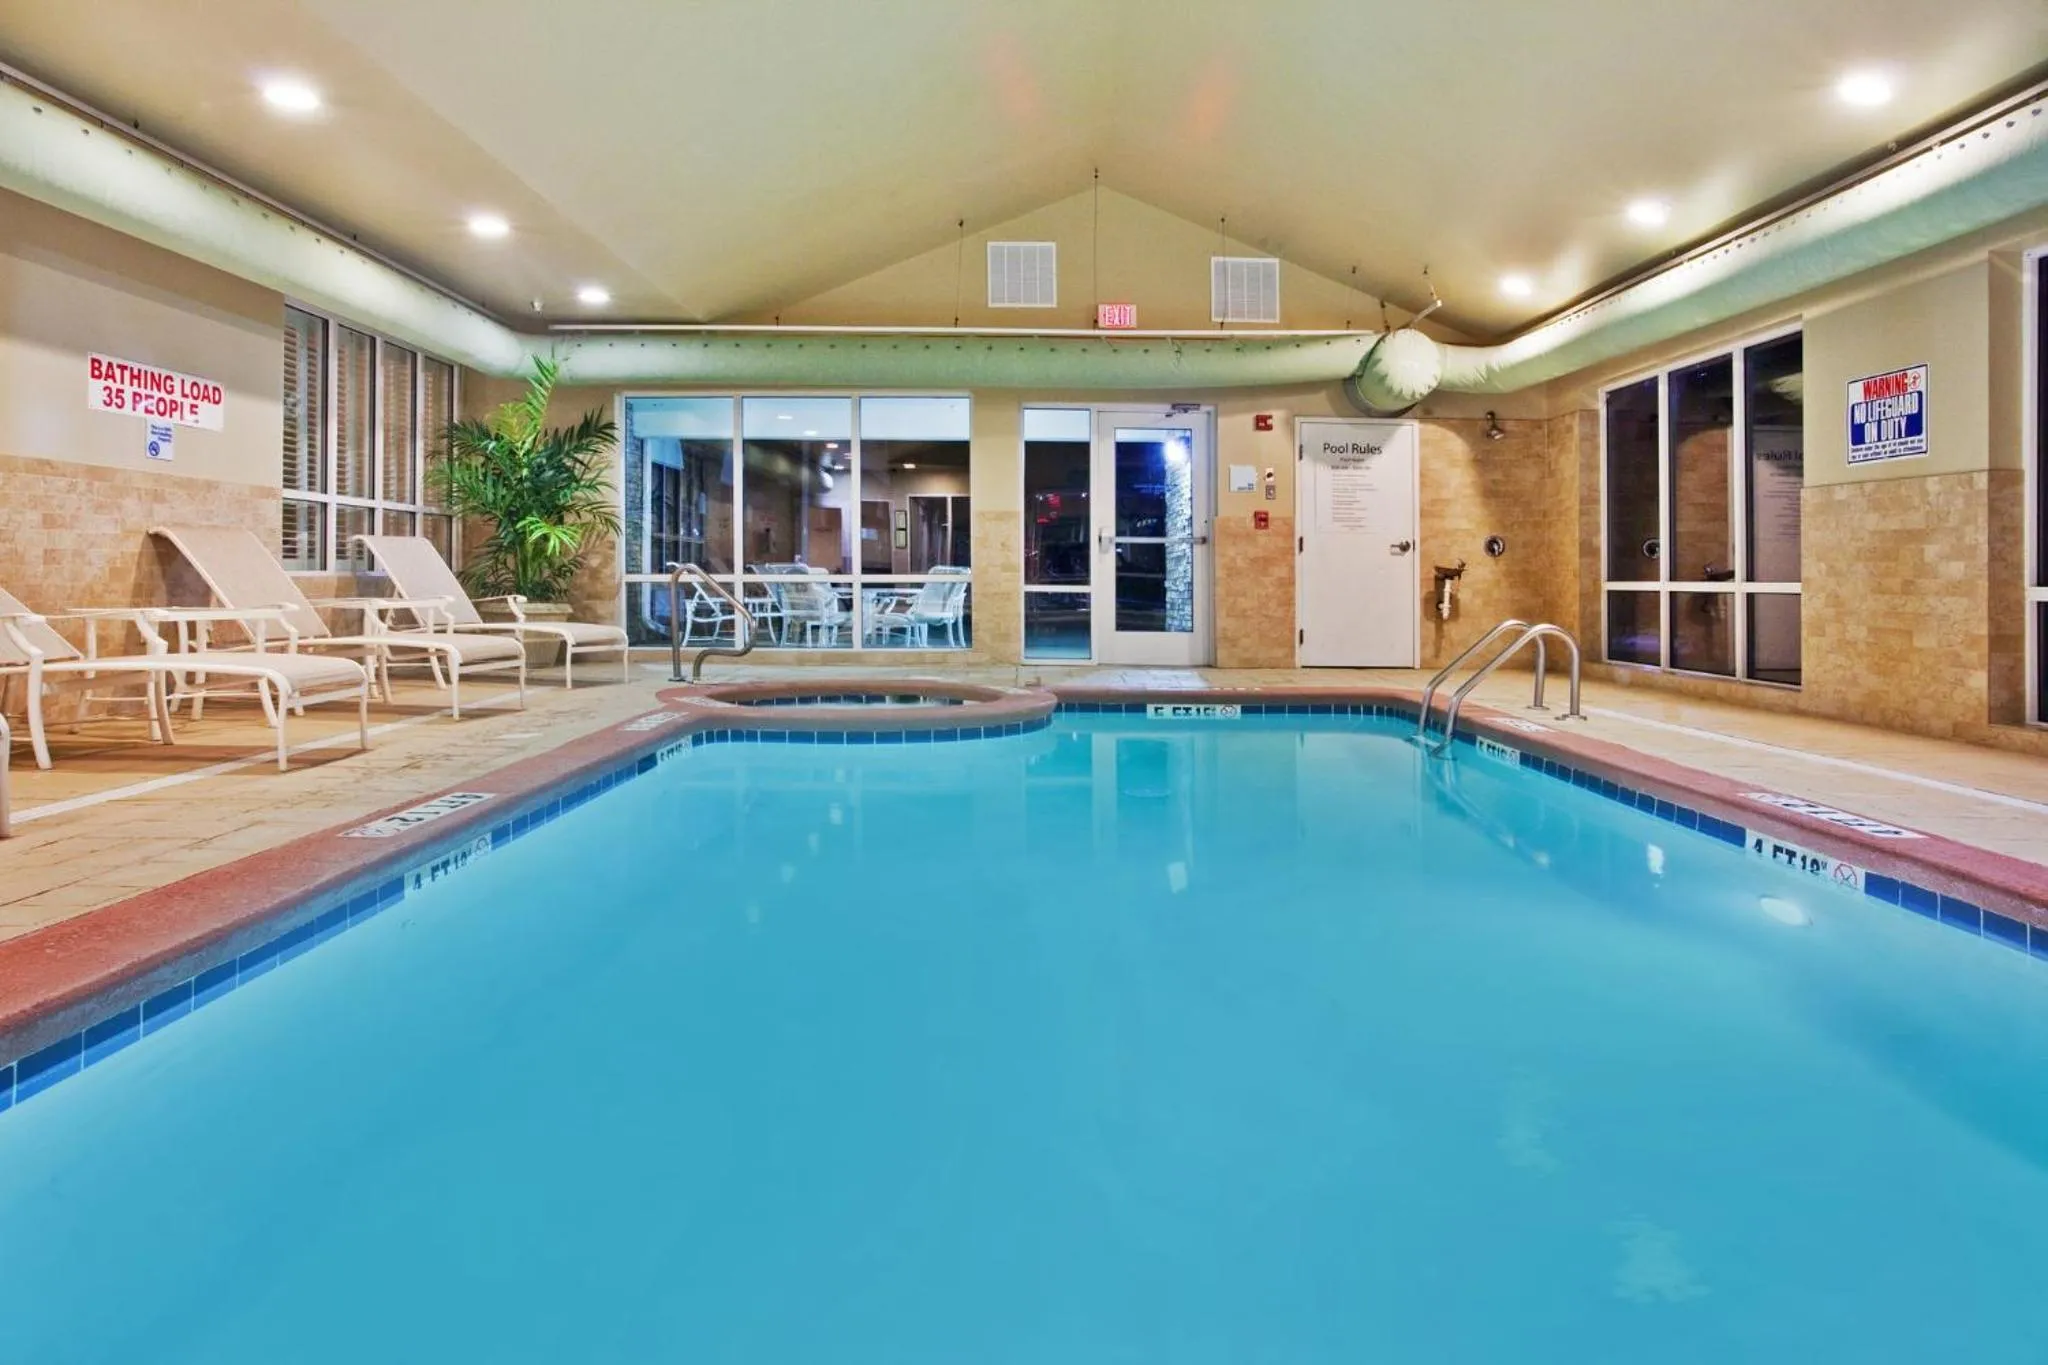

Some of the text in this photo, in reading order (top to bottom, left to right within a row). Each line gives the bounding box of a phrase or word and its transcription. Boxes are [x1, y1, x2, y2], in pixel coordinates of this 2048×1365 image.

[90, 357, 222, 405] BATHING LOAD
[1863, 372, 1909, 400] WARNING
[102, 386, 125, 409] 35
[1853, 391, 1919, 425] NO LIFEGUARD
[1864, 415, 1907, 444] ON DUTY
[1323, 442, 1383, 455] Pool Rules
[1772, 844, 1797, 865] FT
[431, 858, 450, 882] FT
